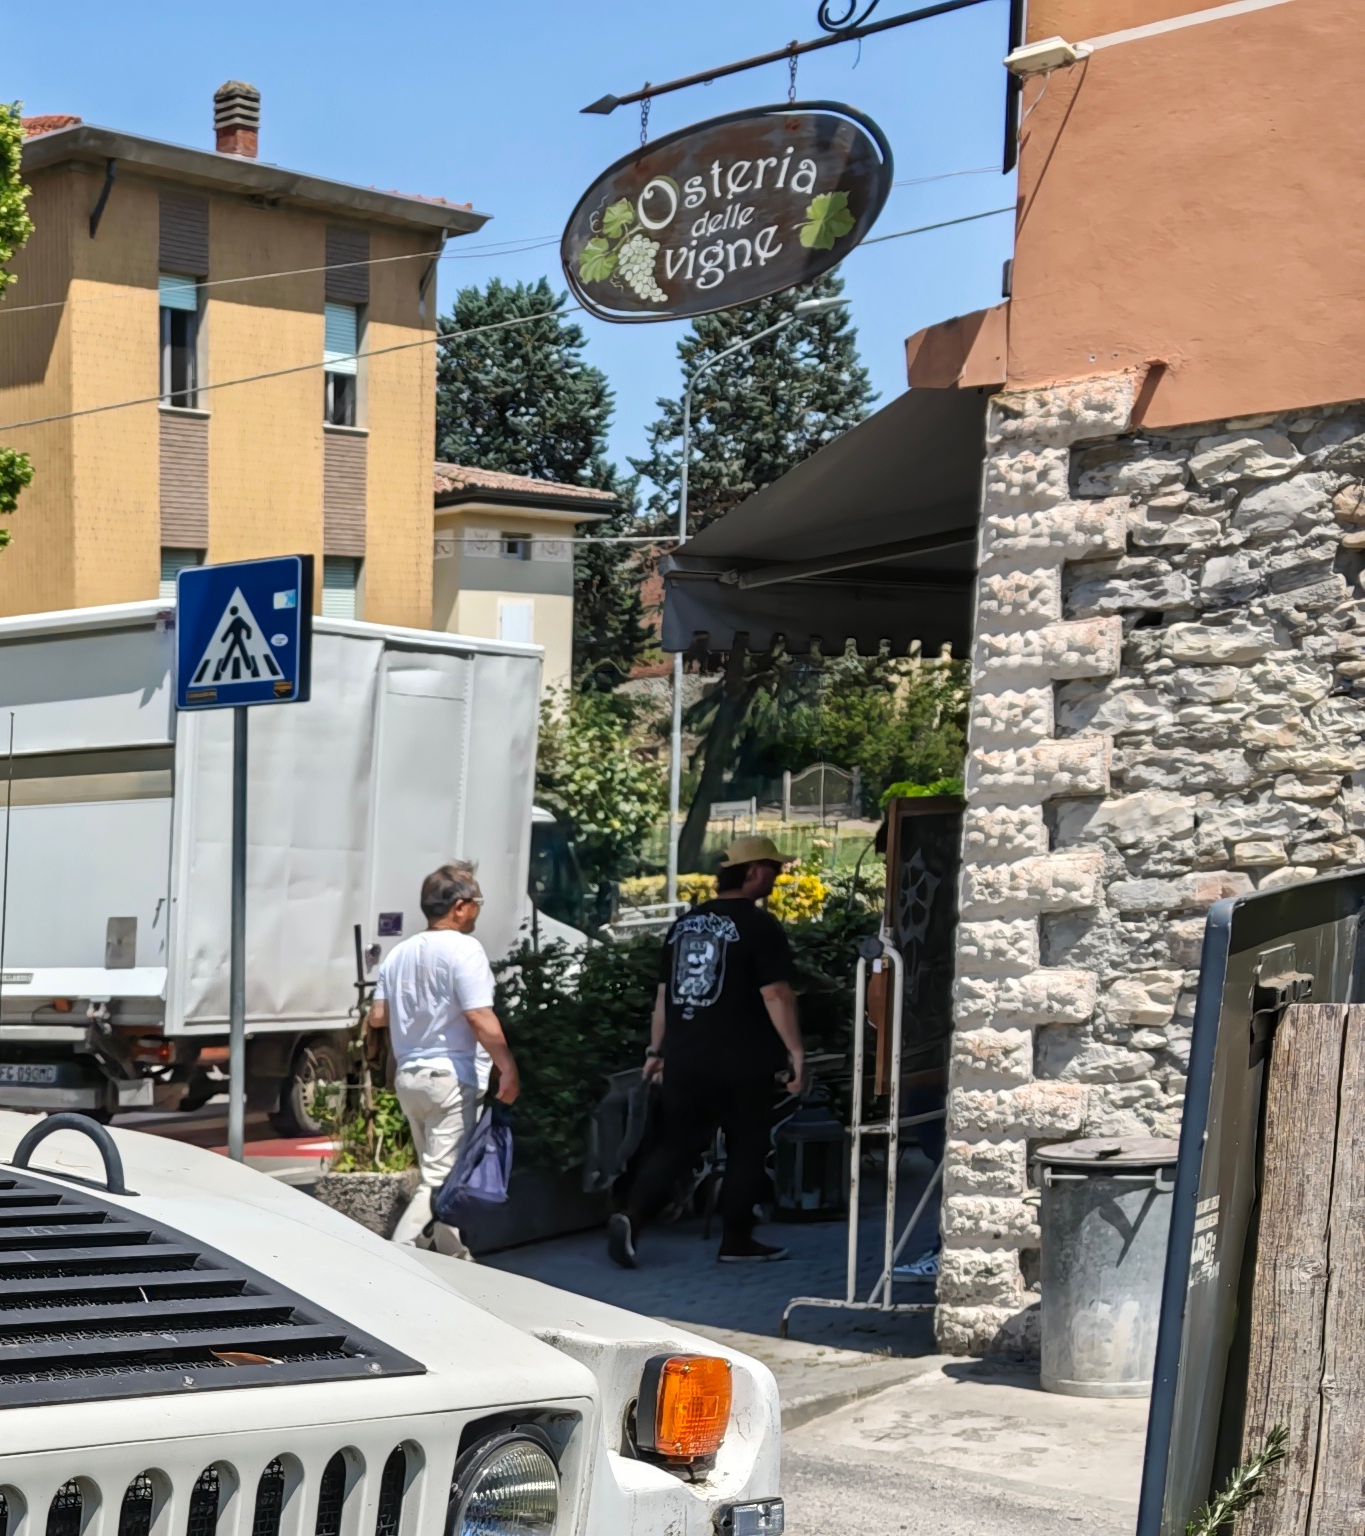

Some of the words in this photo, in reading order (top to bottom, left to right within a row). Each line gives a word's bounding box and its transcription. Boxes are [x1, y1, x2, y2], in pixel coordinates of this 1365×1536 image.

[638, 147, 818, 229] Osteria
[691, 204, 755, 238] delle
[665, 225, 782, 289] vigne
